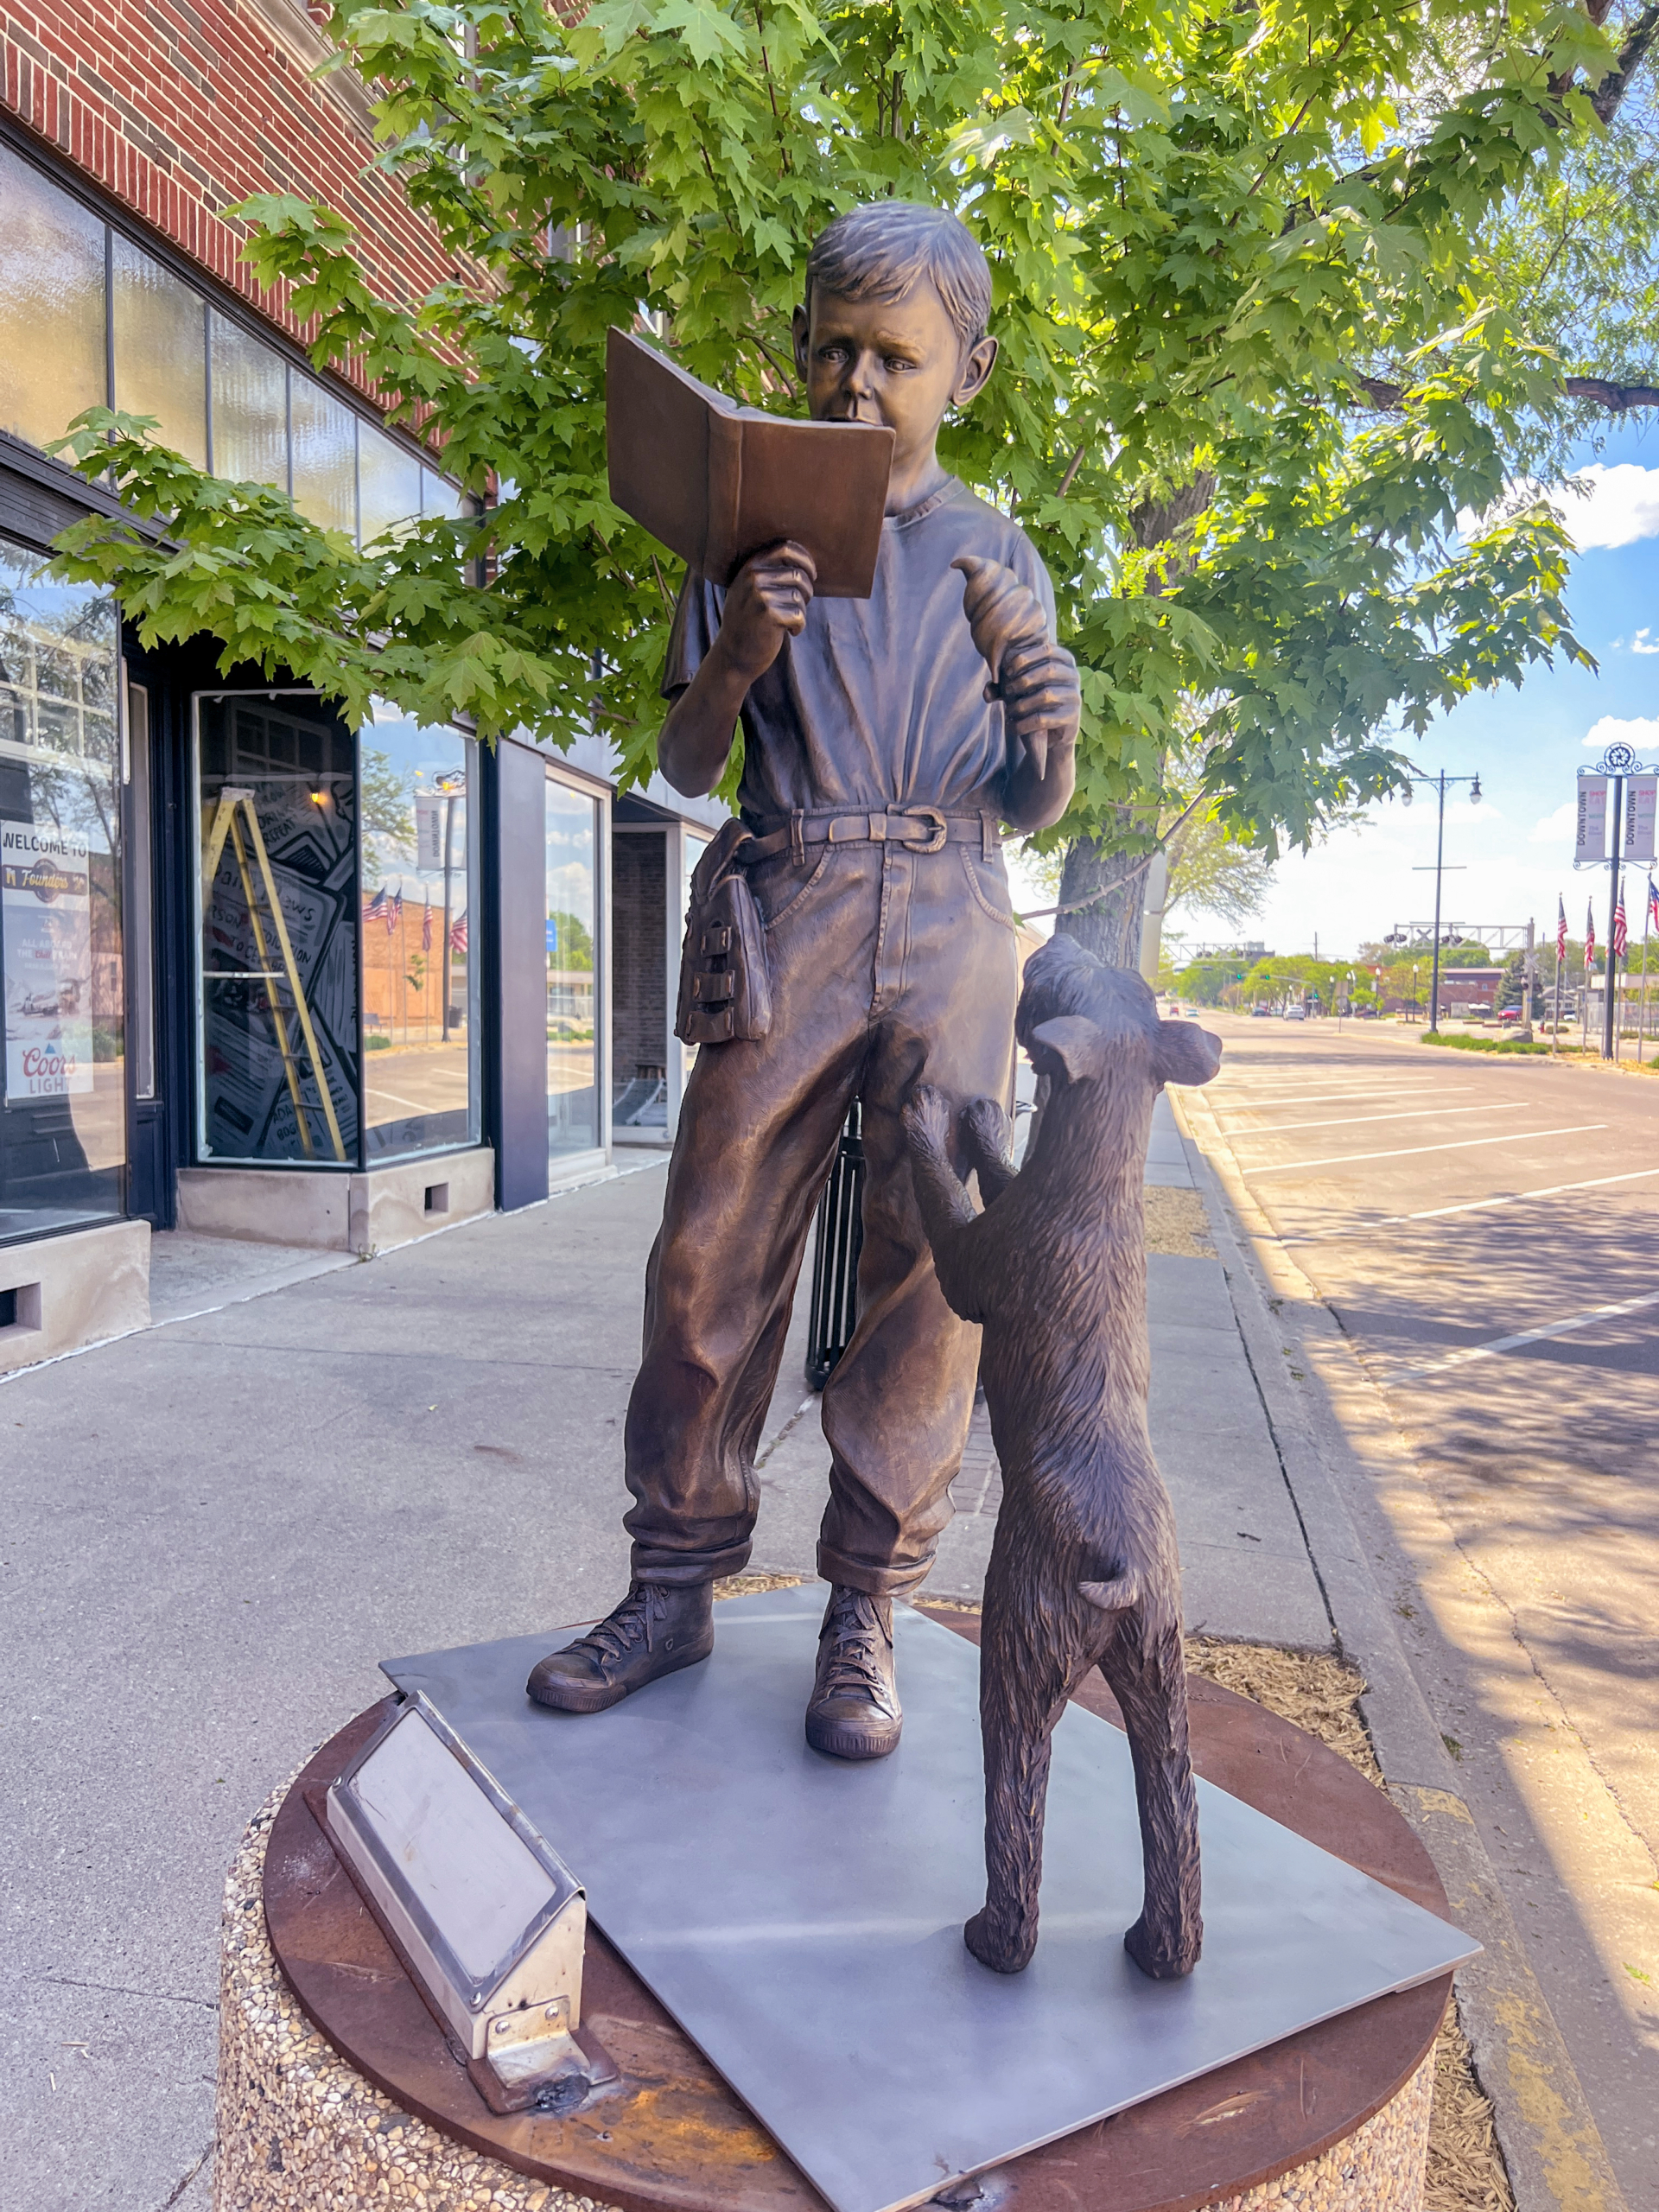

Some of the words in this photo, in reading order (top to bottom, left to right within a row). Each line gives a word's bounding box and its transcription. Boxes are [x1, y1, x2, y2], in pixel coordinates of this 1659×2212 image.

[1577, 791, 1586, 846] DOWNTOWN
[1626, 791, 1636, 845] DOWNTOWN
[3, 833, 68, 855] WELCOME
[72, 842, 87, 858] TO
[22, 869, 68, 889] Founders
[22, 1046, 76, 1077] Coors
